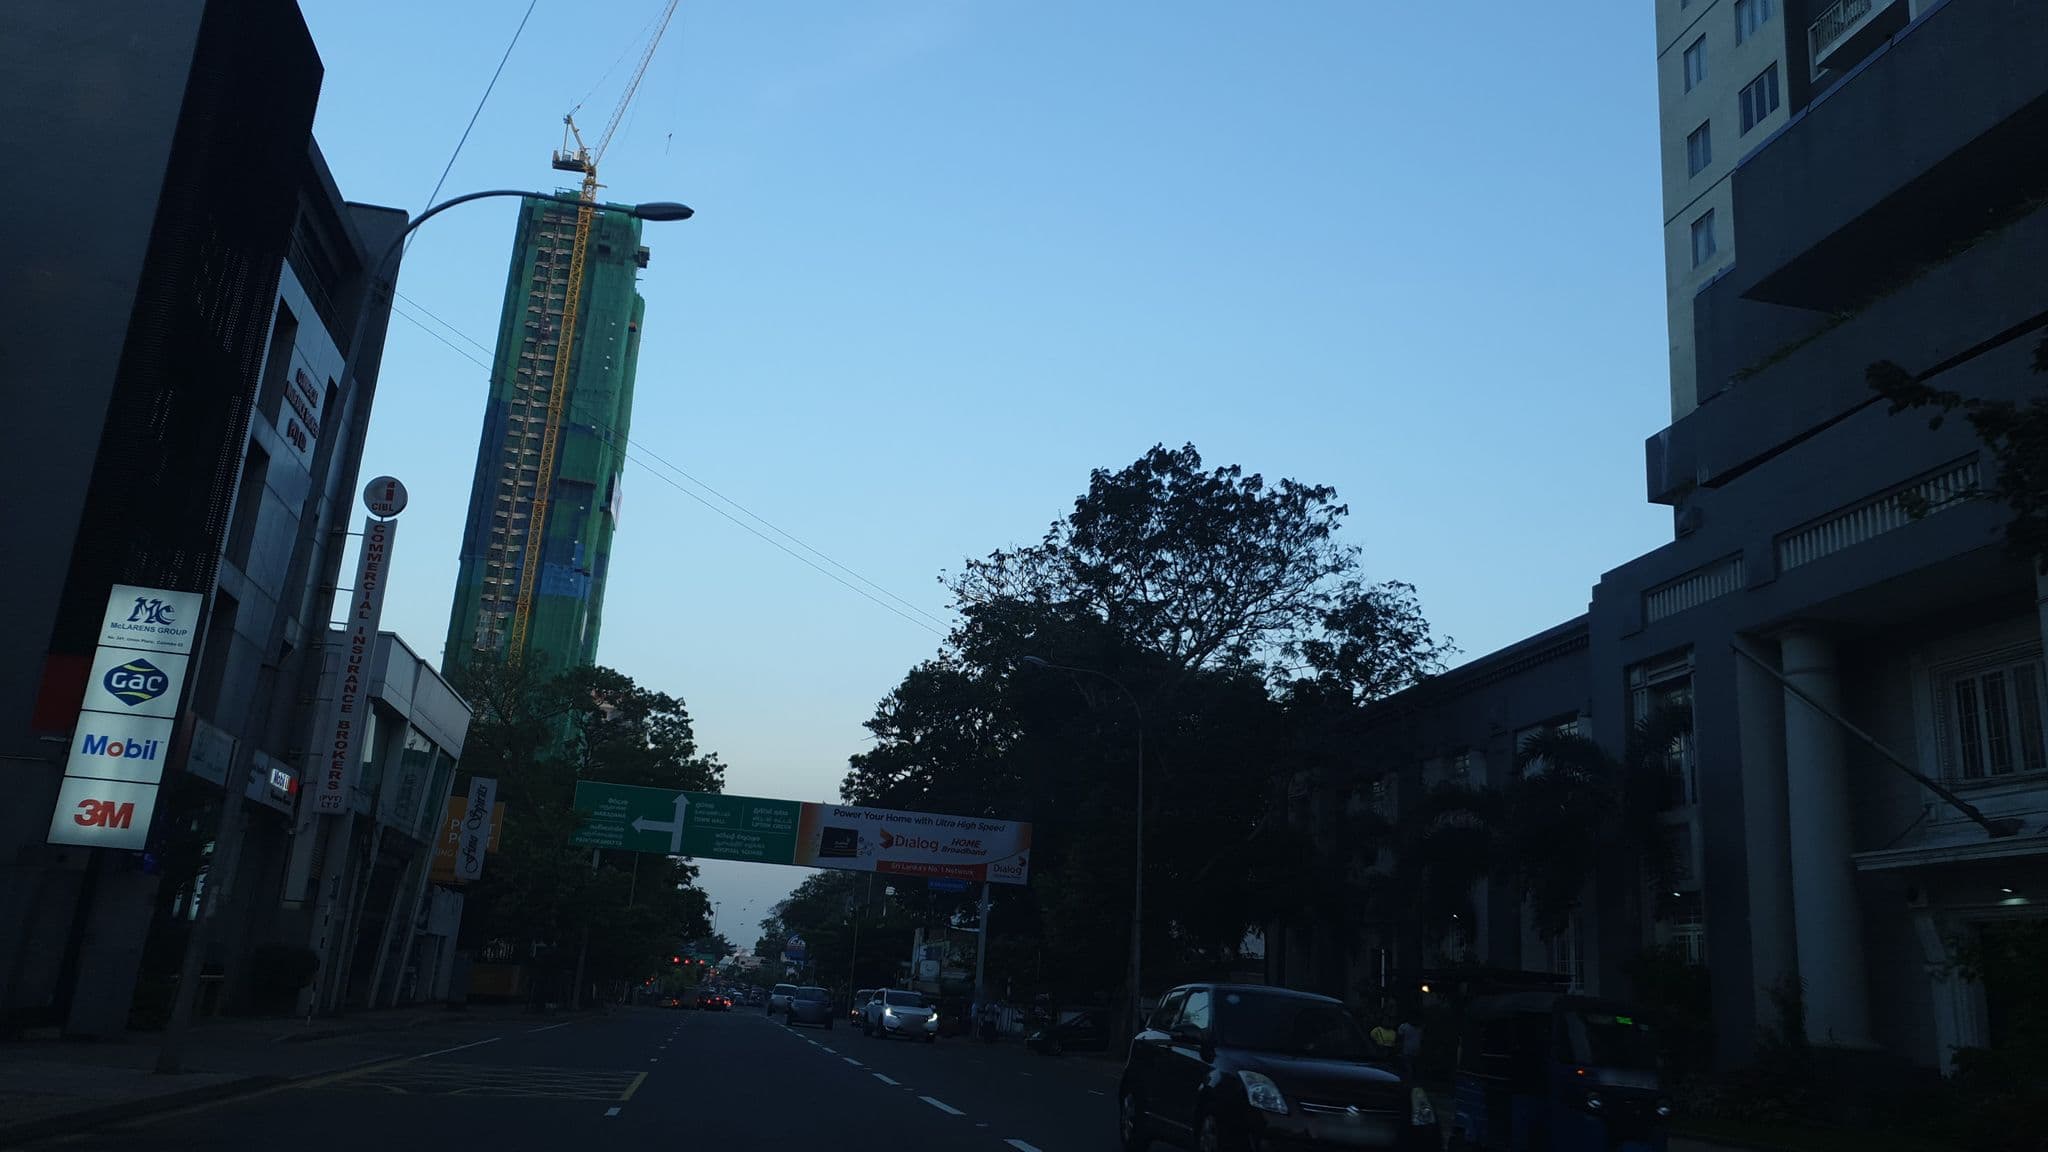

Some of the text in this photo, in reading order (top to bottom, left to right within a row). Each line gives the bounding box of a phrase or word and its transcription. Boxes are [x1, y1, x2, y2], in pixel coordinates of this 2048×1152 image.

[371, 503, 394, 512] CIBL
[110, 622, 188, 636] McLARENS GROUP
[328, 524, 385, 790] COMMERCIAL INSURANCE BROKERS
[82, 734, 158, 761] Mobil
[74, 798, 136, 830] 3M
[834, 809, 1006, 833] Power Your Home with Ultra High Speed
[895, 834, 939, 853] Dialog
[941, 846, 987, 856] Broadband
[951, 838, 982, 848] HOME
[993, 864, 1022, 876] Dialog
